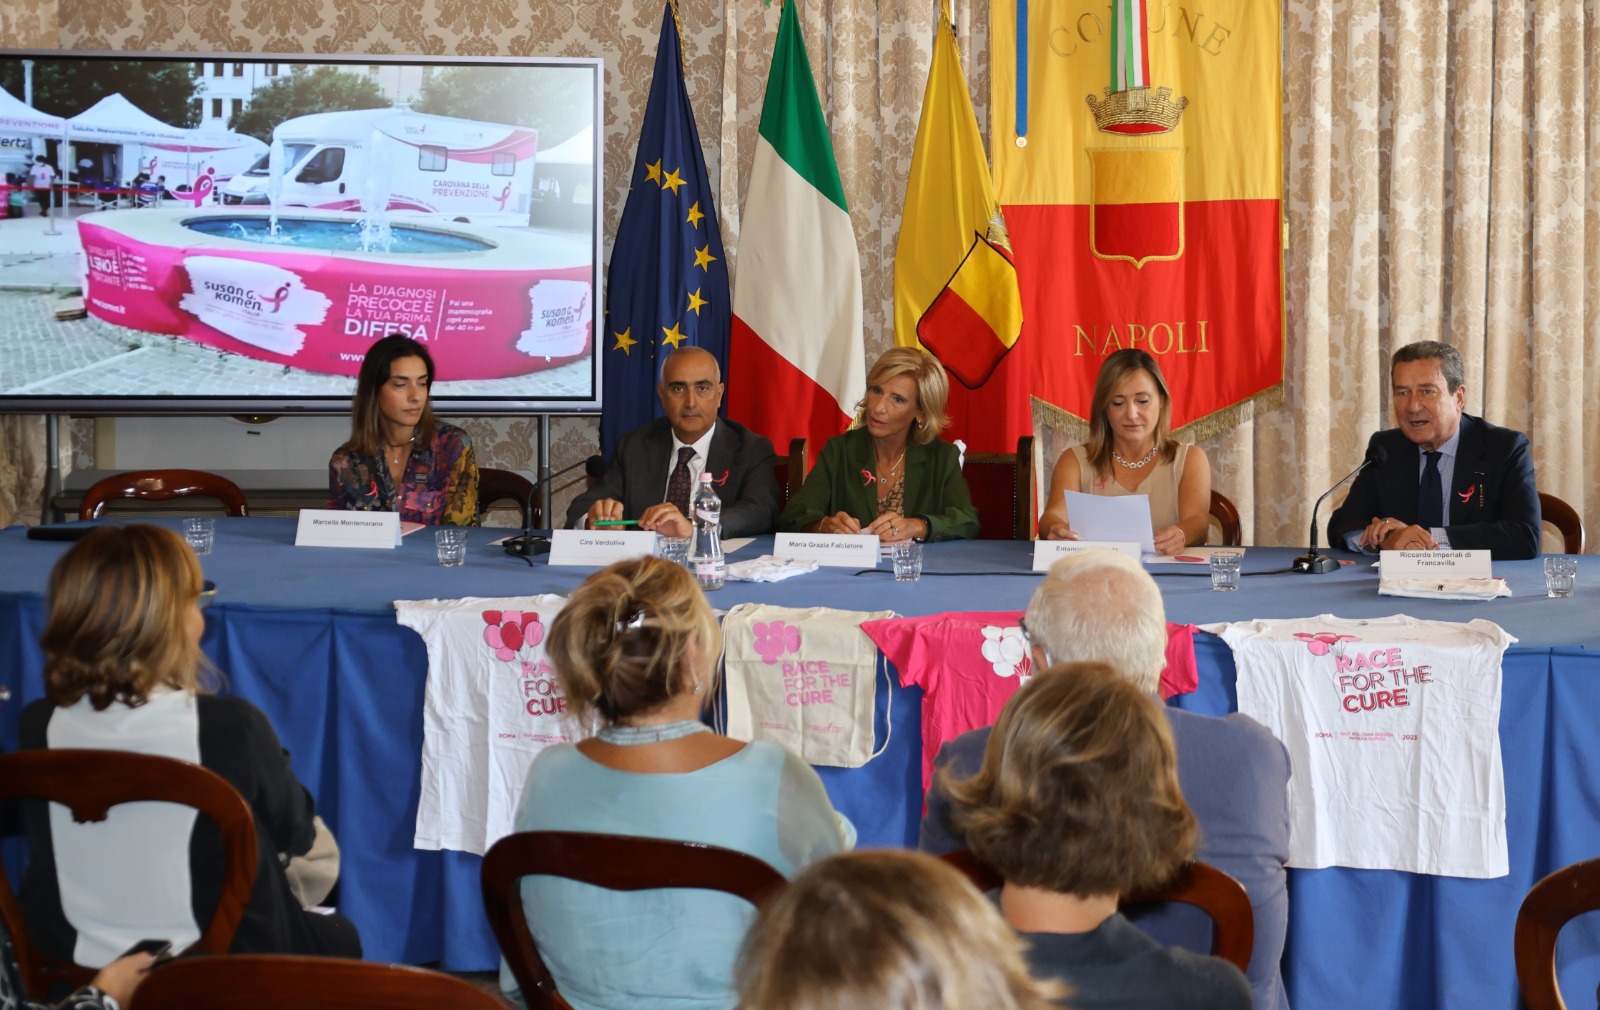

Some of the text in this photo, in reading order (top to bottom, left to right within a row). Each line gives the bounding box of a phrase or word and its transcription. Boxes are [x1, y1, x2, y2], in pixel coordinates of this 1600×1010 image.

[1049, 3, 1231, 57] COUNE
[432, 188, 489, 198] PREVENZIONE
[433, 180, 490, 190] CAROVANA DELLA
[204, 281, 257, 301] susan G.
[349, 282, 437, 299] LA DIAGNOSI
[215, 291, 264, 312] komen.
[347, 294, 423, 313] PRECOCE
[346, 307, 431, 323] LA TUA PRIMA
[541, 307, 567, 319] susan
[344, 318, 428, 341] DIFESA
[1072, 320, 1209, 356] NAPOLI
[340, 519, 384, 527] Montemarano
[595, 539, 625, 547] Verdoliva
[808, 541, 830, 549] Grazia
[1400, 551, 1431, 559] Riccardo
[1432, 551, 1463, 560] Imperiali
[1417, 559, 1456, 567] Francavilla
[520, 659, 552, 678] RA
[782, 660, 830, 677] RACE
[1335, 647, 1404, 674] RACE
[784, 673, 851, 691] FOR THE
[1338, 665, 1434, 693] FOR THE
[526, 696, 568, 716] CUR
[786, 690, 834, 707] CURE
[1342, 688, 1410, 714] CURE
